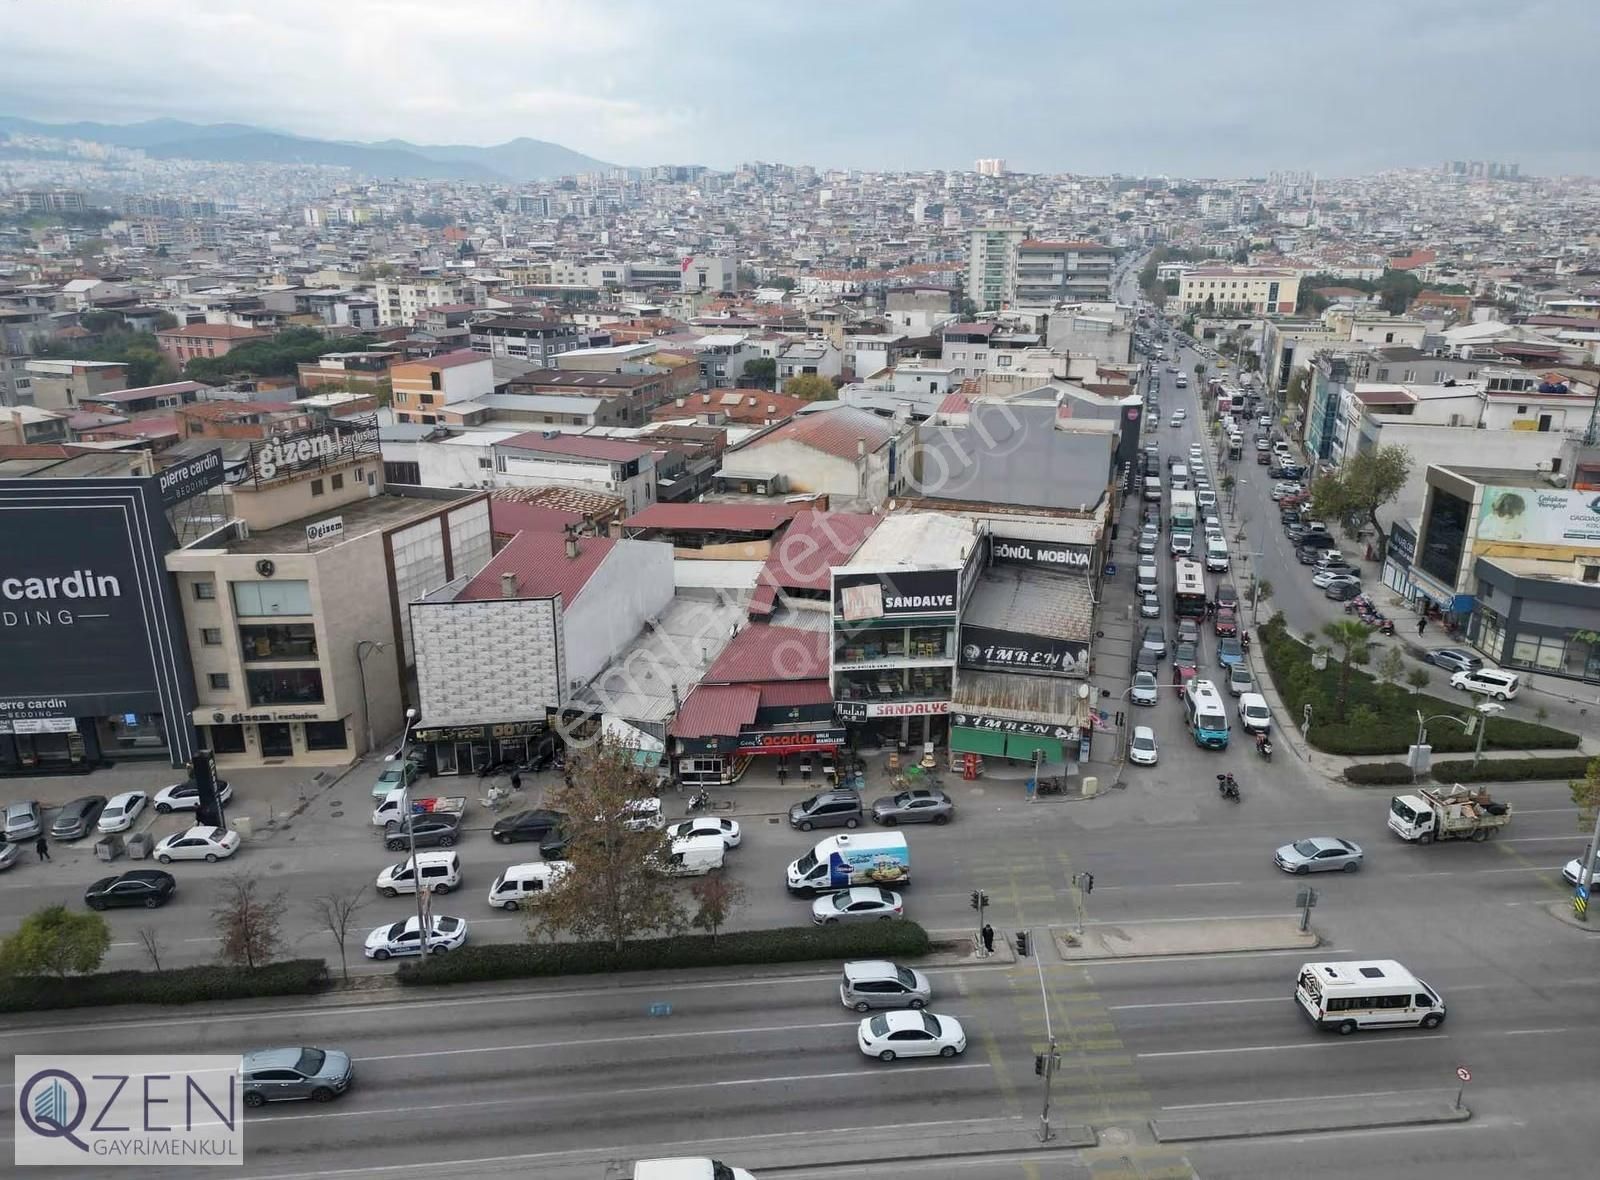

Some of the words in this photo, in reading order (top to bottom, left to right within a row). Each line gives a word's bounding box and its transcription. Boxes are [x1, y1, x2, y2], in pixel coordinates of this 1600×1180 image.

[258, 433, 334, 480] gizem
[160, 466, 189, 494] pierre
[190, 453, 219, 477] cardin
[176, 476, 209, 498] BEDDING
[1037, 549, 1089, 565] MOBİLYA
[2, 568, 121, 602] cardin
[885, 594, 953, 608] SANDALYE
[3, 609, 74, 626] DING
[984, 645, 1061, 664] İMREN
[27, 698, 67, 709] cardin
[876, 702, 949, 715] SANDALYE
[8, 710, 53, 718] BEDDING
[231, 712, 271, 723] gizem
[277, 712, 320, 720] exclusive
[972, 715, 1050, 733] İMREN
[763, 732, 816, 745] acarlar
